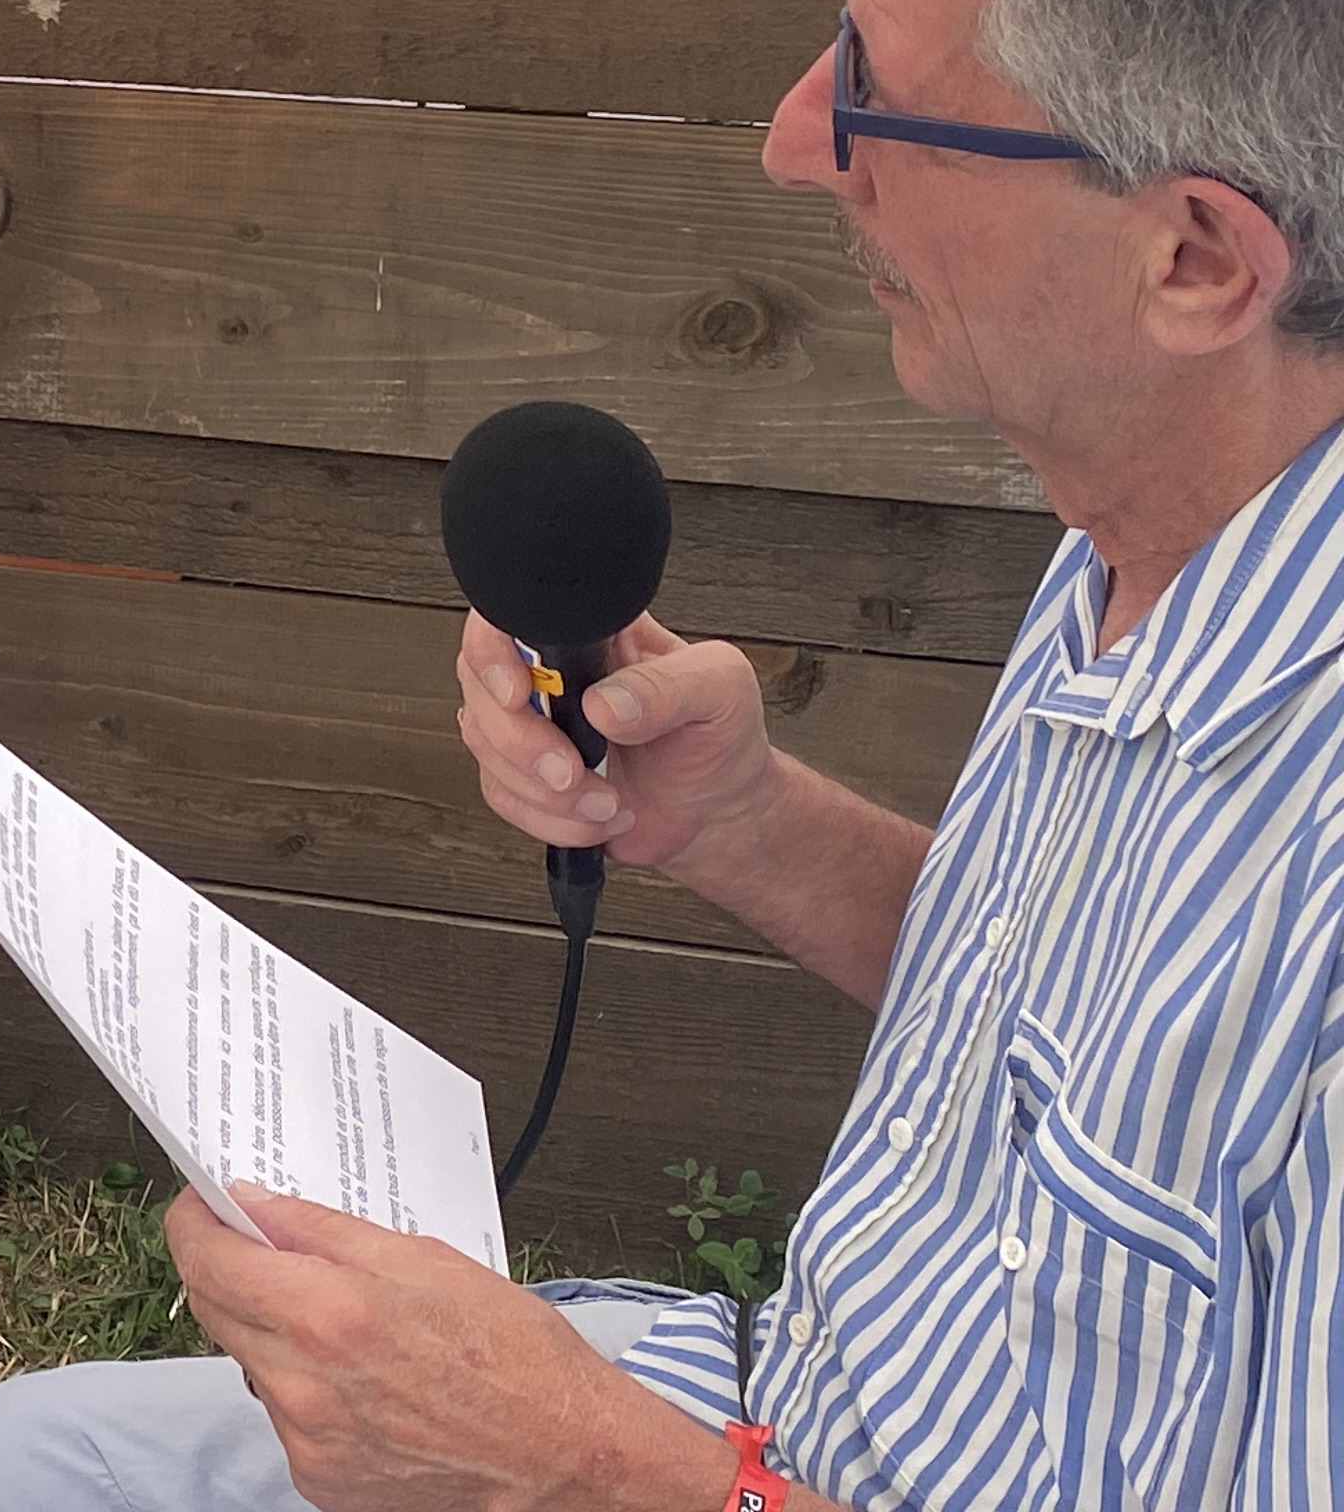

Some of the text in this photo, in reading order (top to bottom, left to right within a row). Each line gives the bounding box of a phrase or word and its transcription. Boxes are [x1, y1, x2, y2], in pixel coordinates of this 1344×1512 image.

[220, 969, 230, 991] une
[221, 994, 230, 1035] comme
[218, 1039, 230, 1055] ici
[252, 1043, 264, 1065] des
[217, 1059, 233, 1115] présence
[269, 1070, 286, 1147] pousseraient
[348, 1077, 365, 1124] pendant
[379, 1088, 395, 1154] fournisseurs
[219, 1118, 231, 1149] votre
[252, 1125, 265, 1153] faire
[252, 1156, 265, 1174] de
[272, 1147, 283, 1165] ne
[336, 1131, 352, 1176] produit
[385, 1153, 397, 1172] les
[271, 1165, 286, 1187] qui
[338, 1174, 351, 1191] du
[387, 1172, 399, 1199] tous
[354, 1186, 367, 1203] de
